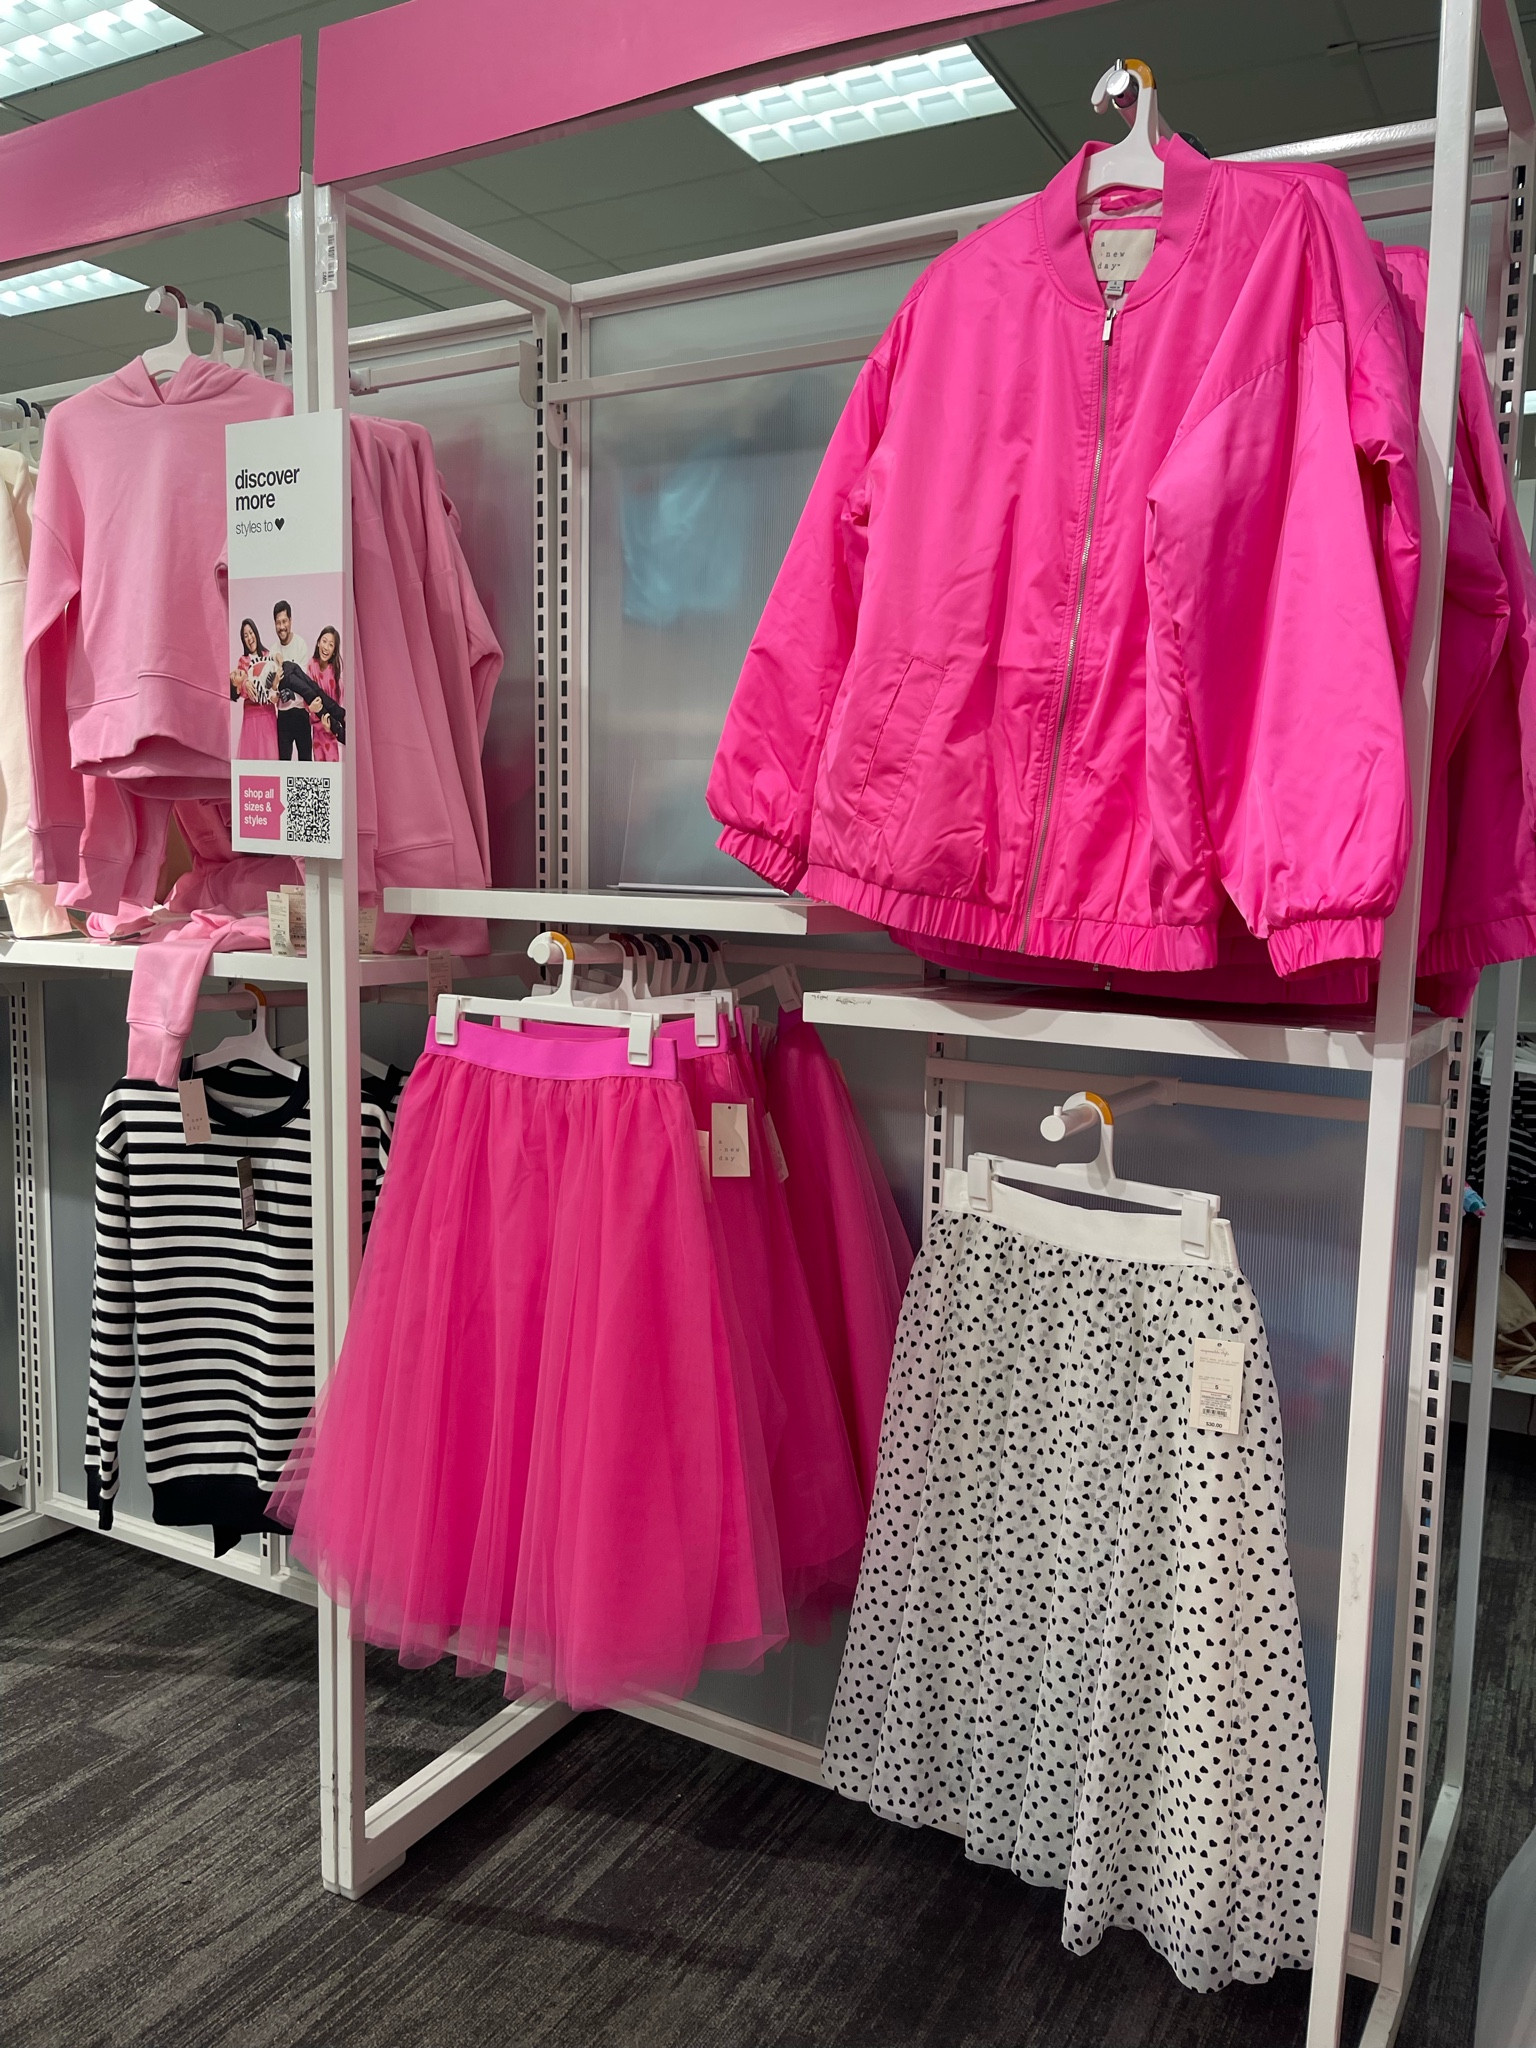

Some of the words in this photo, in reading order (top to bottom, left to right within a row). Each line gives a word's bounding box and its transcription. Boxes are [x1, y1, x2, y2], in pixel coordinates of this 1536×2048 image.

[235, 468, 300, 490] discover
[235, 493, 276, 511] more
[235, 520, 262, 537] styles
[264, 520, 273, 532] to
[243, 787, 263, 800] shop
[264, 788, 275, 799] all
[243, 801, 264, 812] sizes
[265, 801, 272, 813] &
[243, 815, 268, 827] styles
